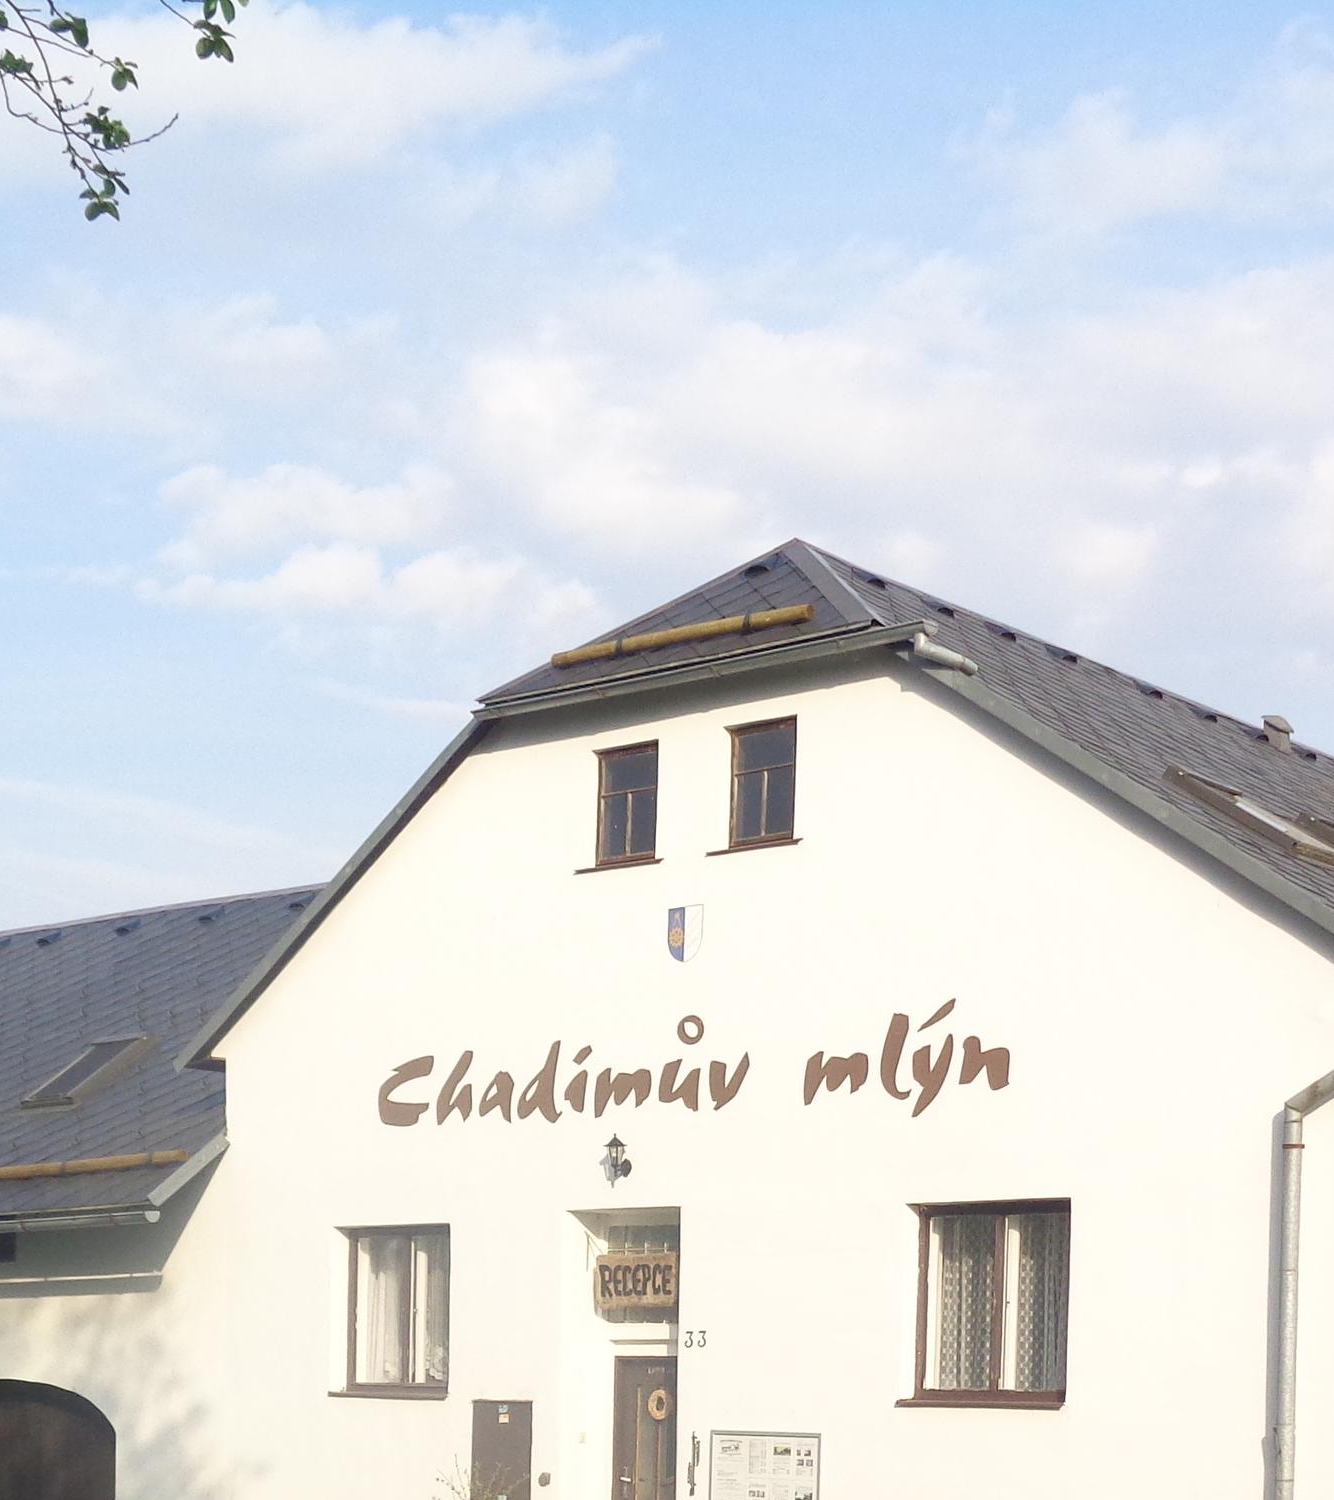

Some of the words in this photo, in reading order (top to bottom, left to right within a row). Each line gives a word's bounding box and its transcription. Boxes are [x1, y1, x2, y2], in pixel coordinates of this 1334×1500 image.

[803, 997, 1011, 1118] mlýn
[598, 1263, 673, 1298] RECEPCE
[684, 1330, 707, 1349] 33
